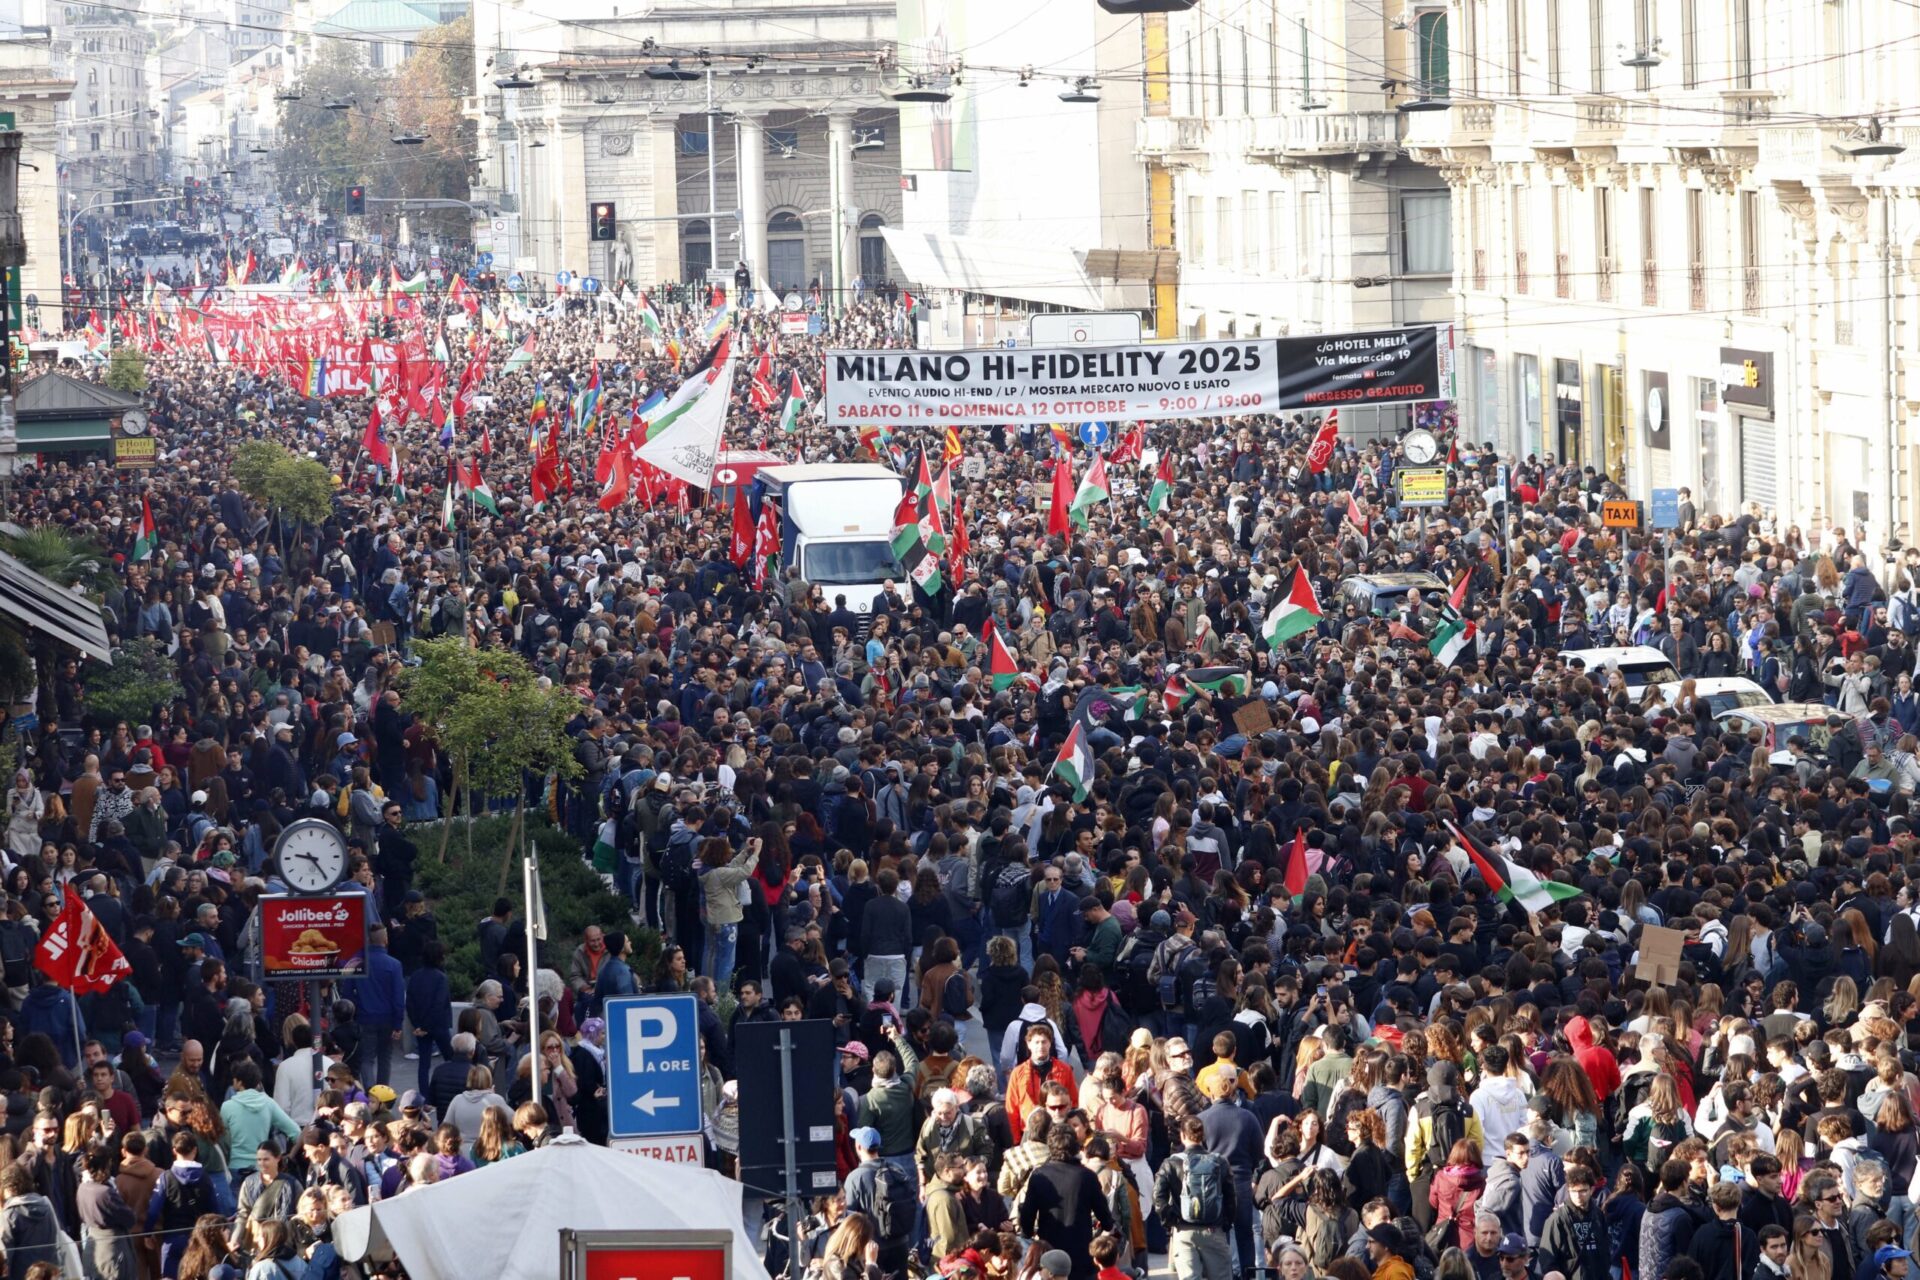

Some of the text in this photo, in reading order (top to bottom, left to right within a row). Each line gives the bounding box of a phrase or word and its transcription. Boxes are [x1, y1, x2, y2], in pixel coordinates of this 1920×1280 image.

[1317, 333, 1409, 352] c/o HOTEL MELIÀ
[836, 345, 1261, 381] MILANO HI-FIDELITY 2025
[1315, 348, 1411, 366] Via Masaccio, 19
[1332, 371, 1361, 380] fermata
[1376, 369, 1395, 377] Lotto
[868, 378, 1230, 398] EVENTO AUDIO HI-END / LP / MOSTRA MERCATO NUOVO E USATO
[1304, 383, 1424, 402] INGRESSO GRATUITO
[838, 404, 901, 417] SABATO
[908, 404, 920, 417] 11
[925, 407, 934, 417] e
[940, 403, 1026, 417] DOMENICA
[1031, 402, 1048, 416] 12
[1053, 400, 1127, 414] OTTOBRE
[1159, 396, 1197, 410] 9:00
[1204, 395, 1211, 409] /
[1217, 393, 1262, 408] 19:00
[126, 439, 150, 447] Hotel
[1605, 508, 1635, 519] TAXI
[277, 907, 333, 922] Jollibee
[625, 1006, 678, 1074] P
[646, 1059, 691, 1072] A ORE
